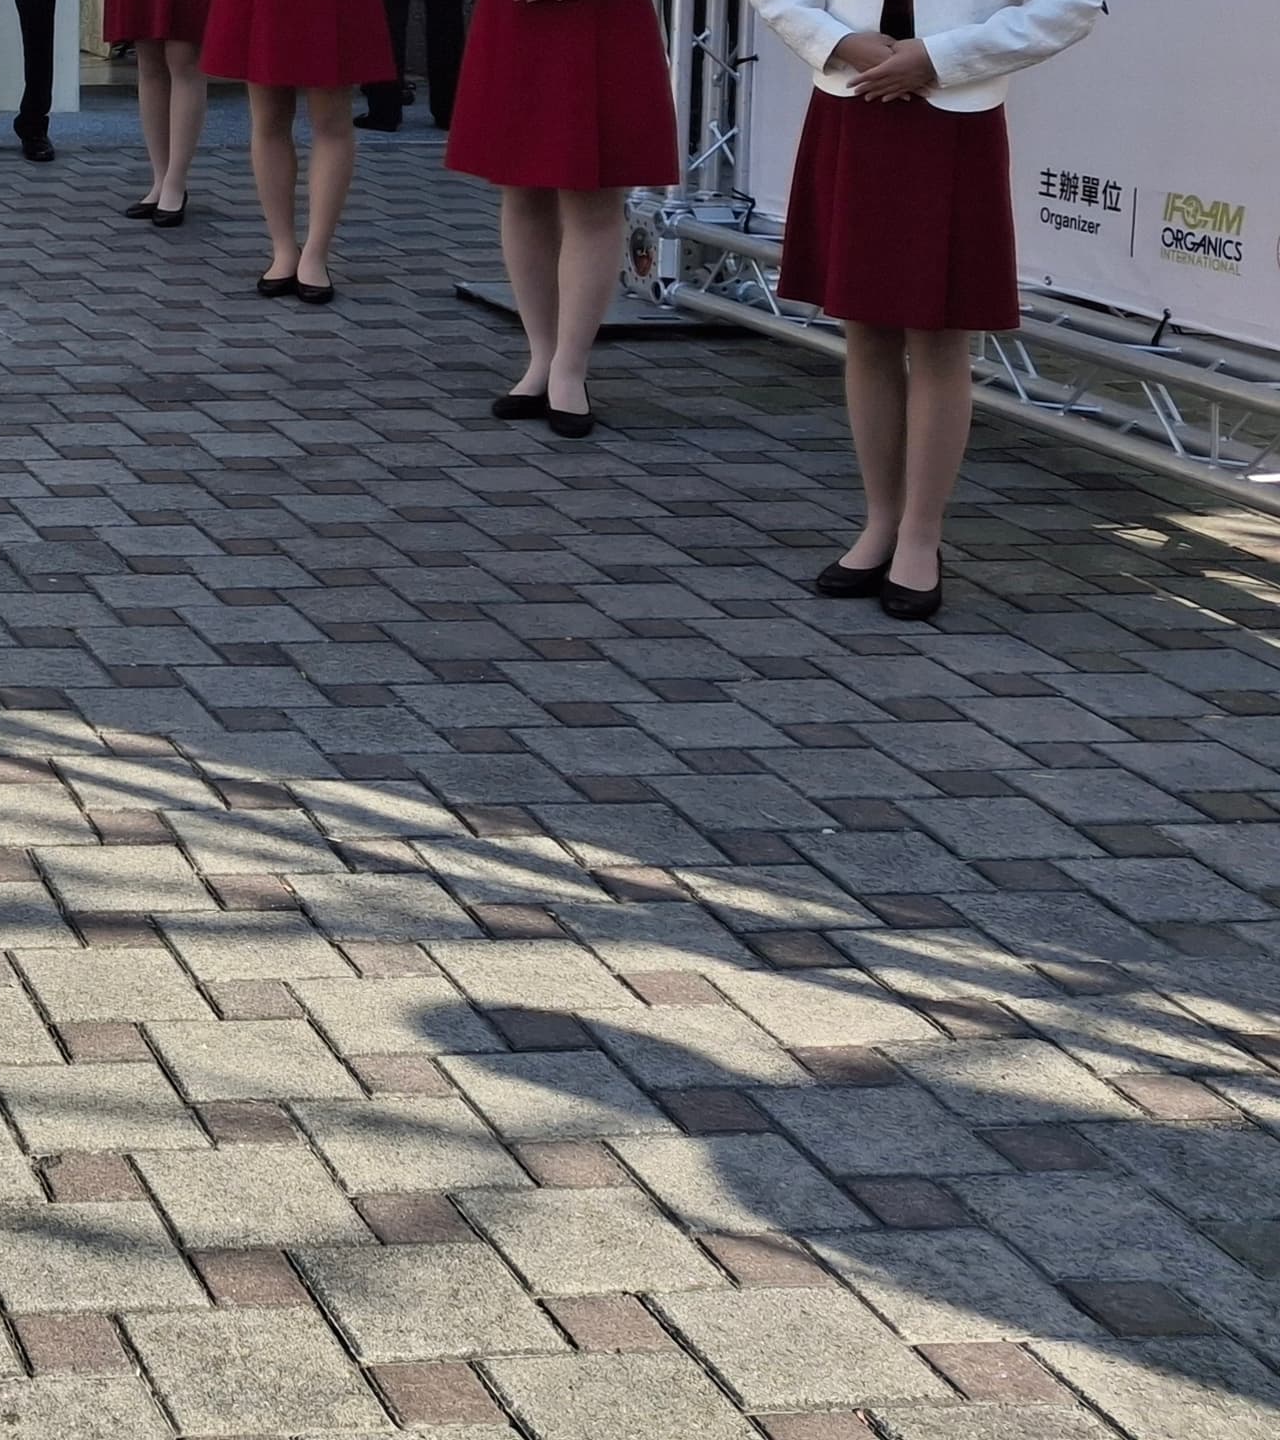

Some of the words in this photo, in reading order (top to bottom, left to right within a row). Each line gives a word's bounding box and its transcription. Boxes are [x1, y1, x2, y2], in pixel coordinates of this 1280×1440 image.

[1039, 167, 1123, 213] 主辦單位
[1040, 206, 1101, 235] Organizer
[1162, 191, 1247, 236] IFOAM
[1160, 247, 1241, 276] INTERNATIONAL
[1161, 227, 1243, 262] ORGANICS
